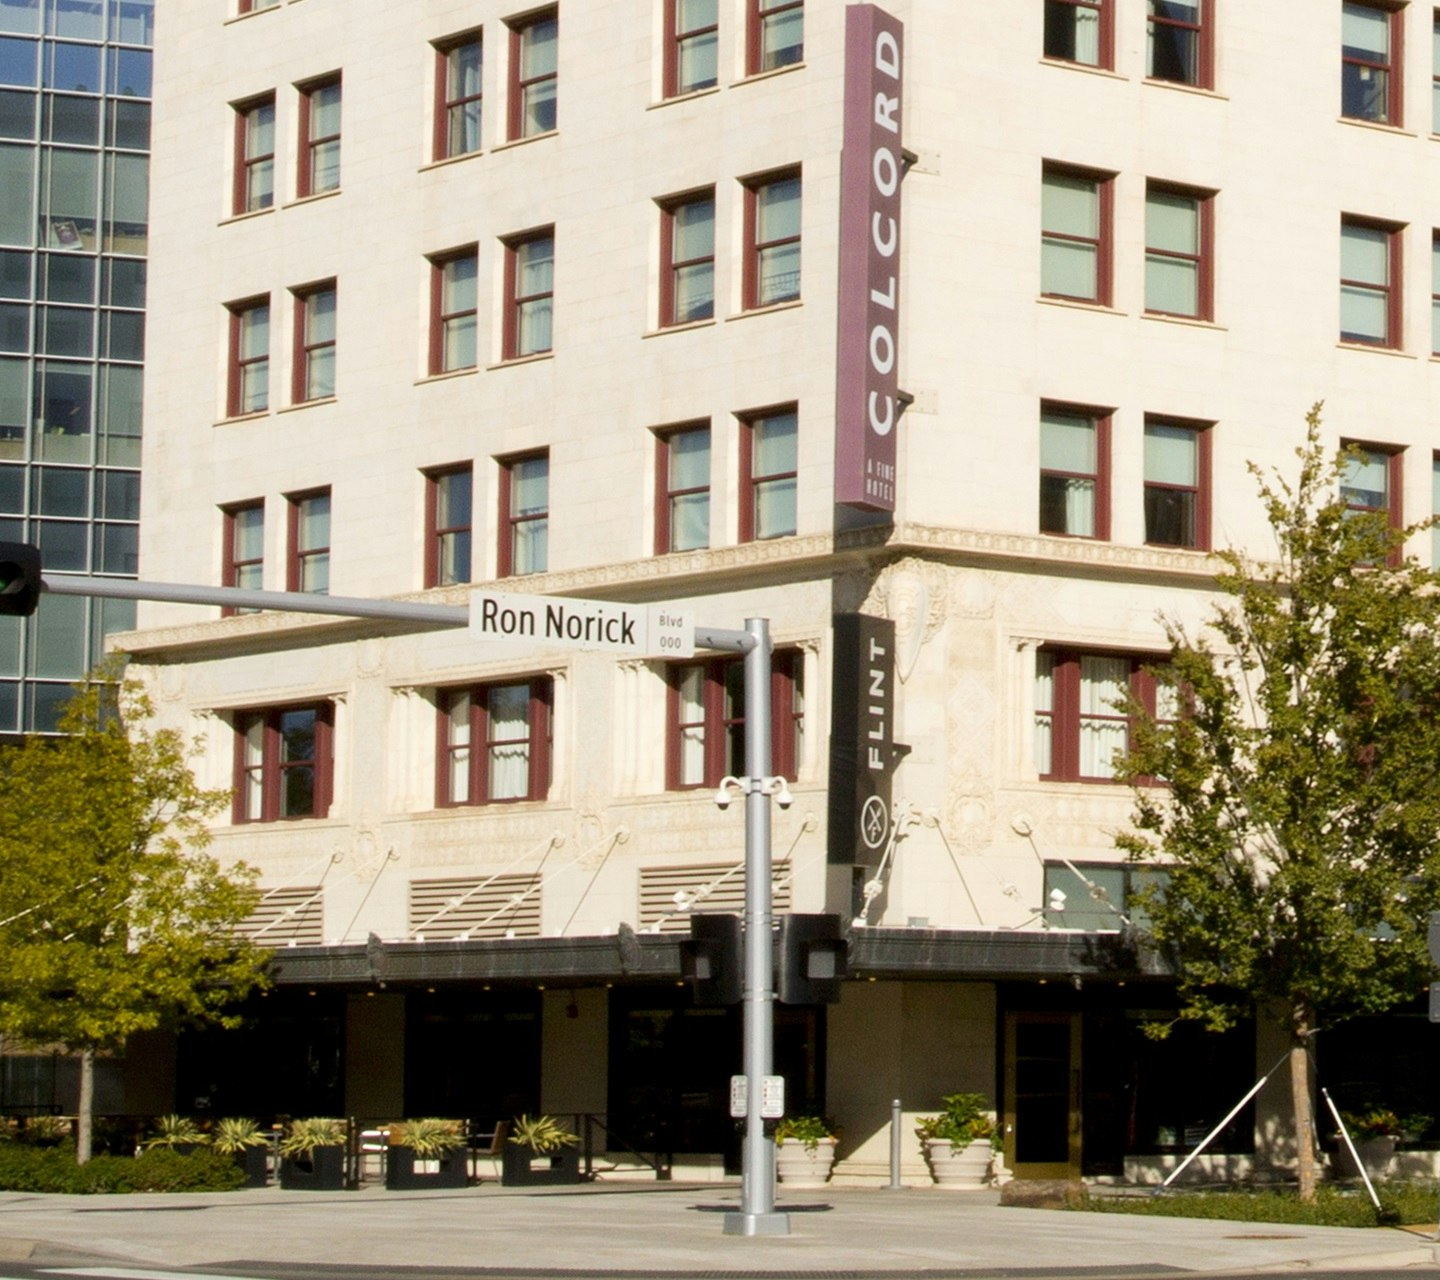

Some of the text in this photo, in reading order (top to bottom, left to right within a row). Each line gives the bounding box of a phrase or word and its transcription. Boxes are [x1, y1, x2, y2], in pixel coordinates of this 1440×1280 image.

[868, 30, 900, 437] COLCORD
[876, 461, 895, 482] FINE
[866, 478, 895, 502] HOTEL
[481, 598, 636, 645] Ron Norick
[659, 614, 684, 628] Blvd
[659, 636, 682, 649] 000
[868, 637, 886, 770] FLINT
